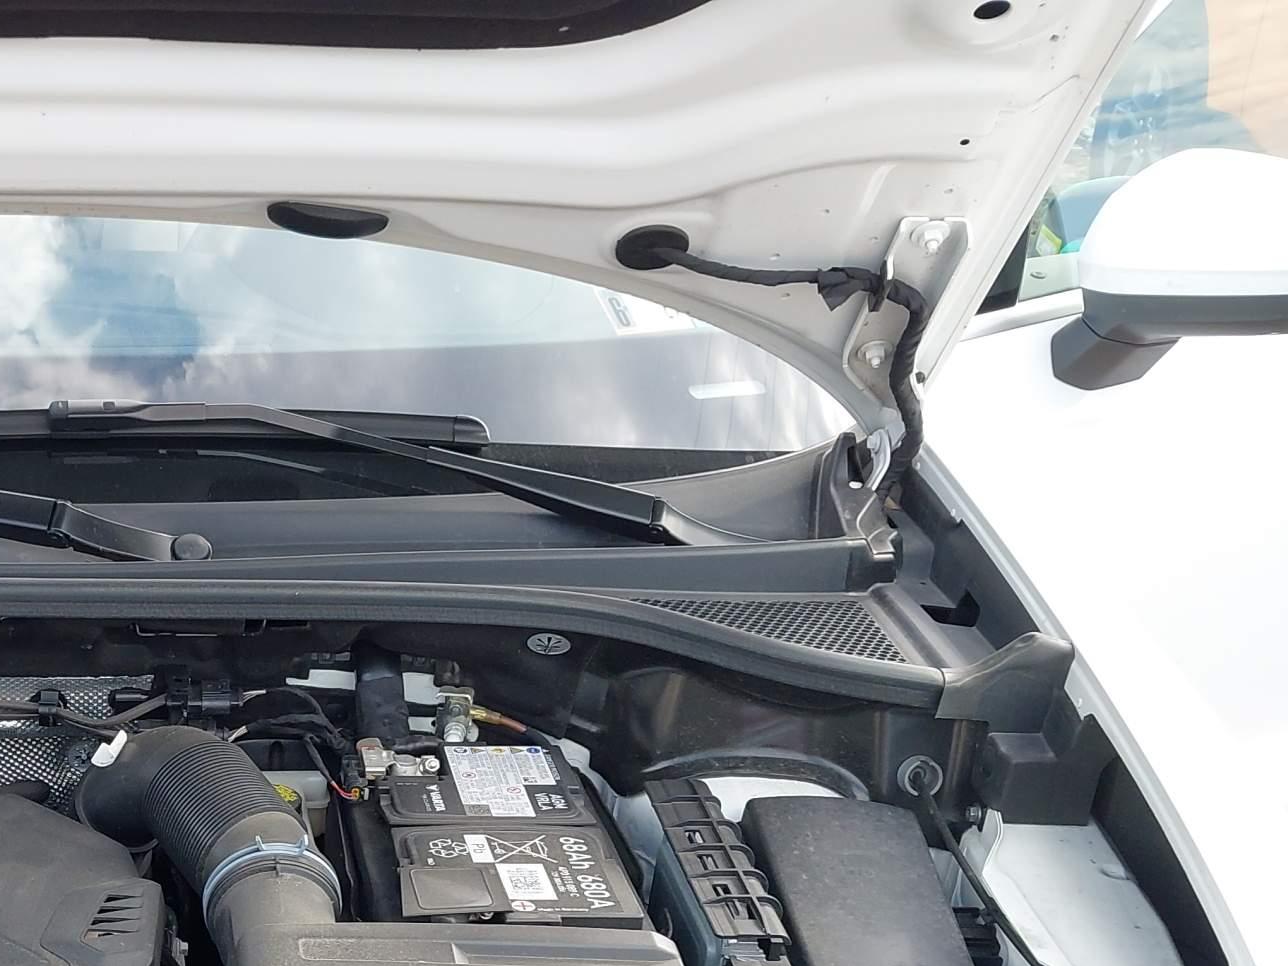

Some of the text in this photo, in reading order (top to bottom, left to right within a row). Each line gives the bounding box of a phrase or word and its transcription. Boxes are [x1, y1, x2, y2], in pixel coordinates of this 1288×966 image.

[430, 791, 446, 811] VARTA
[535, 793, 553, 811] VRLA
[549, 793, 568, 809] AGM
[471, 843, 485, 854] Pb
[560, 837, 615, 909] 68Ah 680A
